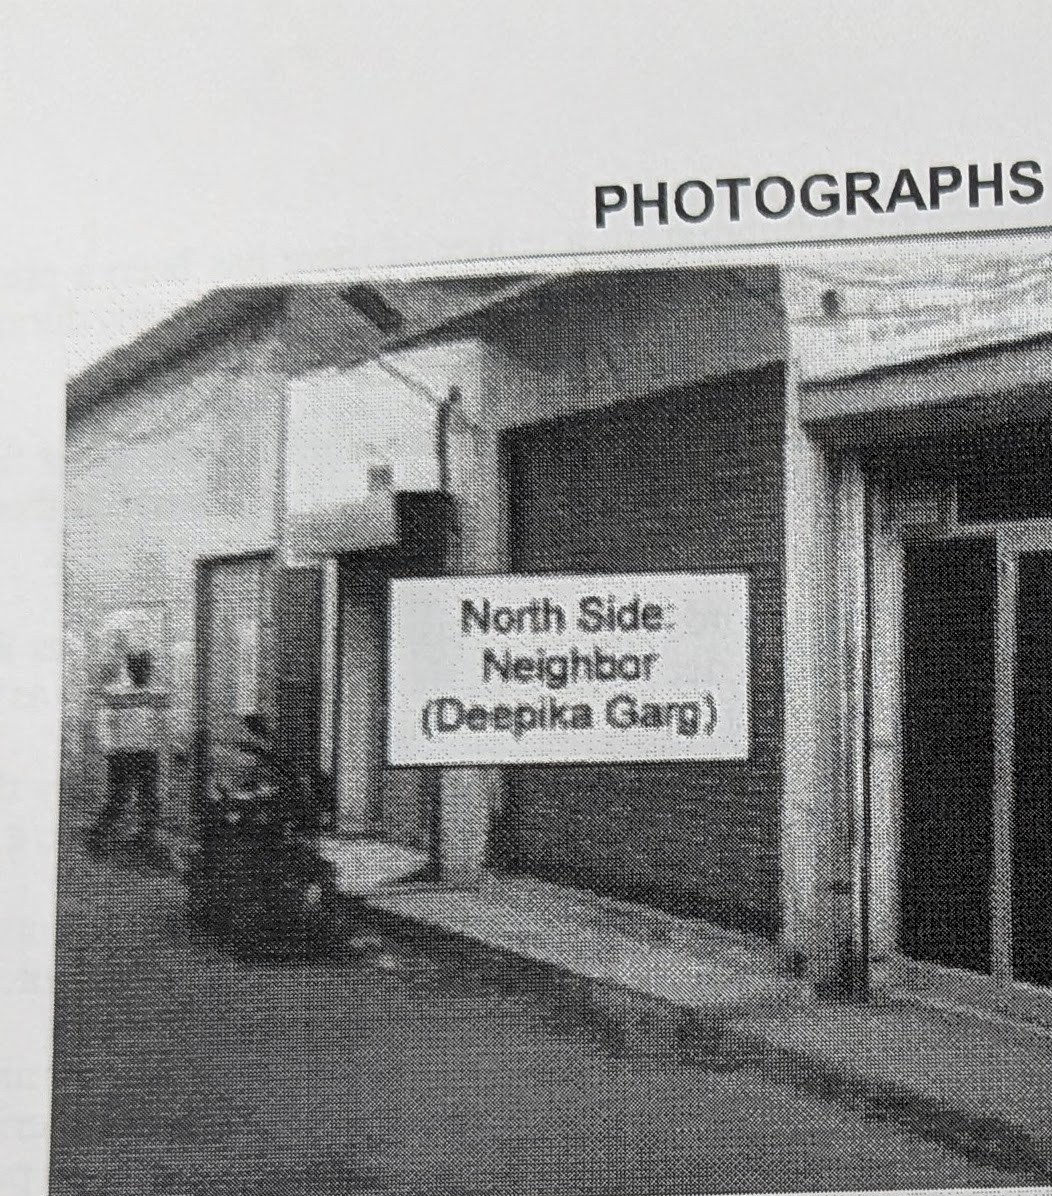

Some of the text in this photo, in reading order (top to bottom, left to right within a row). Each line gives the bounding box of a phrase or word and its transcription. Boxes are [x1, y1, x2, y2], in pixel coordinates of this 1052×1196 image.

[594, 160, 1044, 229] PHOTOGRAPHS
[461, 597, 566, 635] North
[482, 646, 660, 689] Neighbor
[421, 692, 718, 741] (Deepika Garg)
